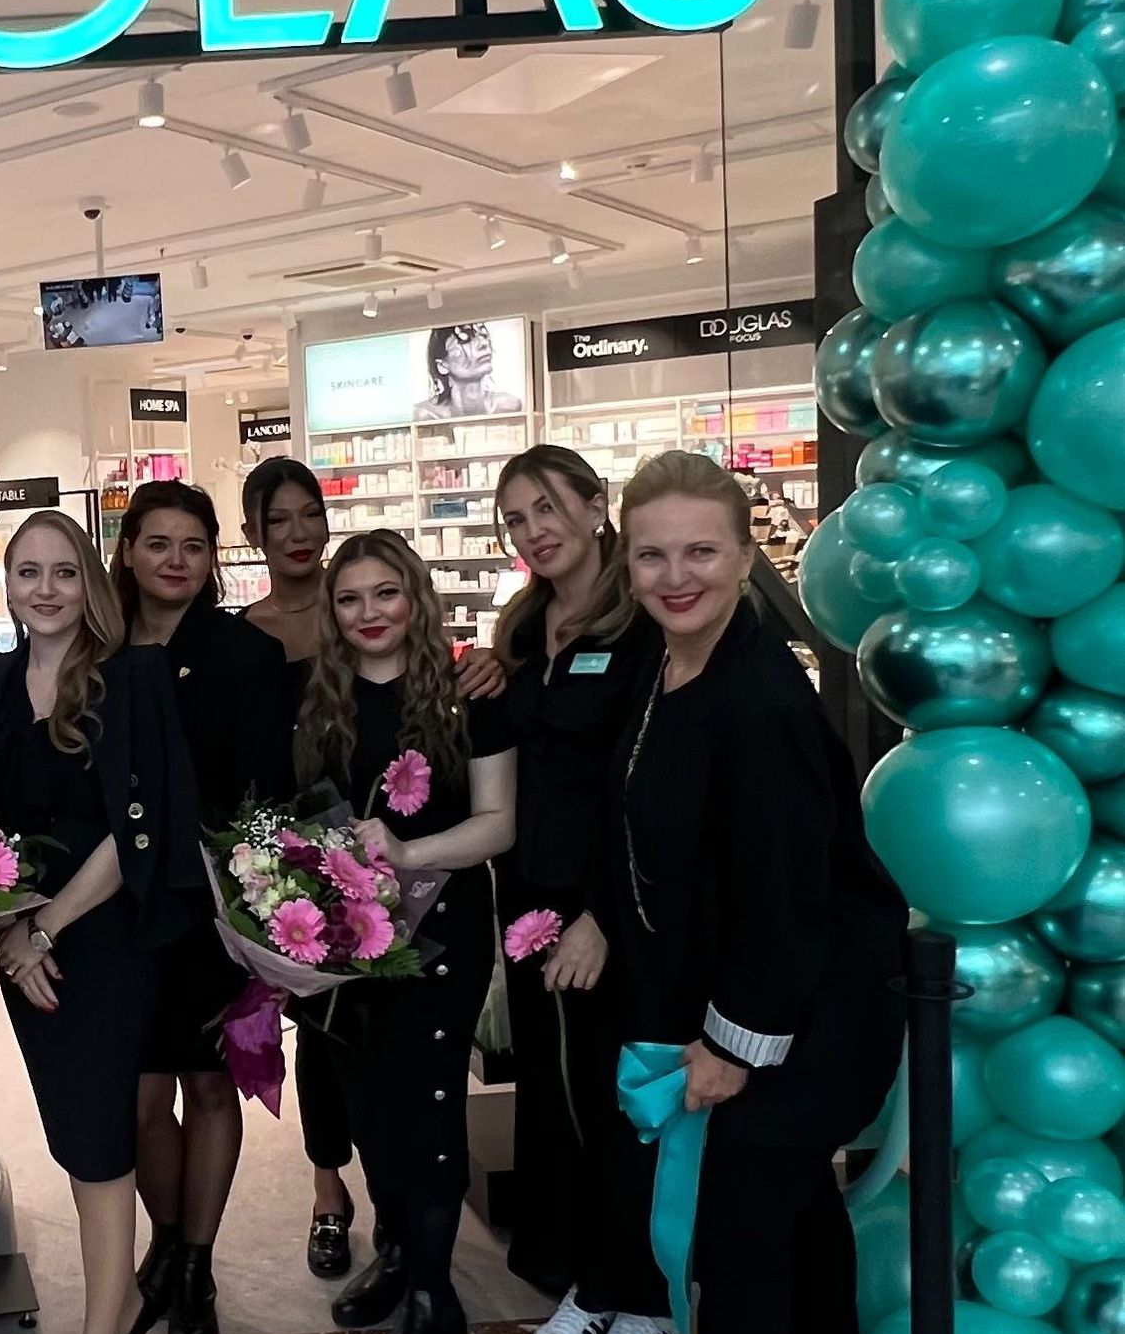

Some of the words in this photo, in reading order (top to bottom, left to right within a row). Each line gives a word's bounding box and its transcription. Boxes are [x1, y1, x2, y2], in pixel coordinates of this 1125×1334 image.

[573, 334, 591, 343] The
[729, 332, 762, 342] FOCUS
[572, 338, 649, 359] Ordinary.
[330, 376, 384, 391] SKINCARE
[139, 398, 164, 412] HOME
[164, 399, 180, 413] SPA
